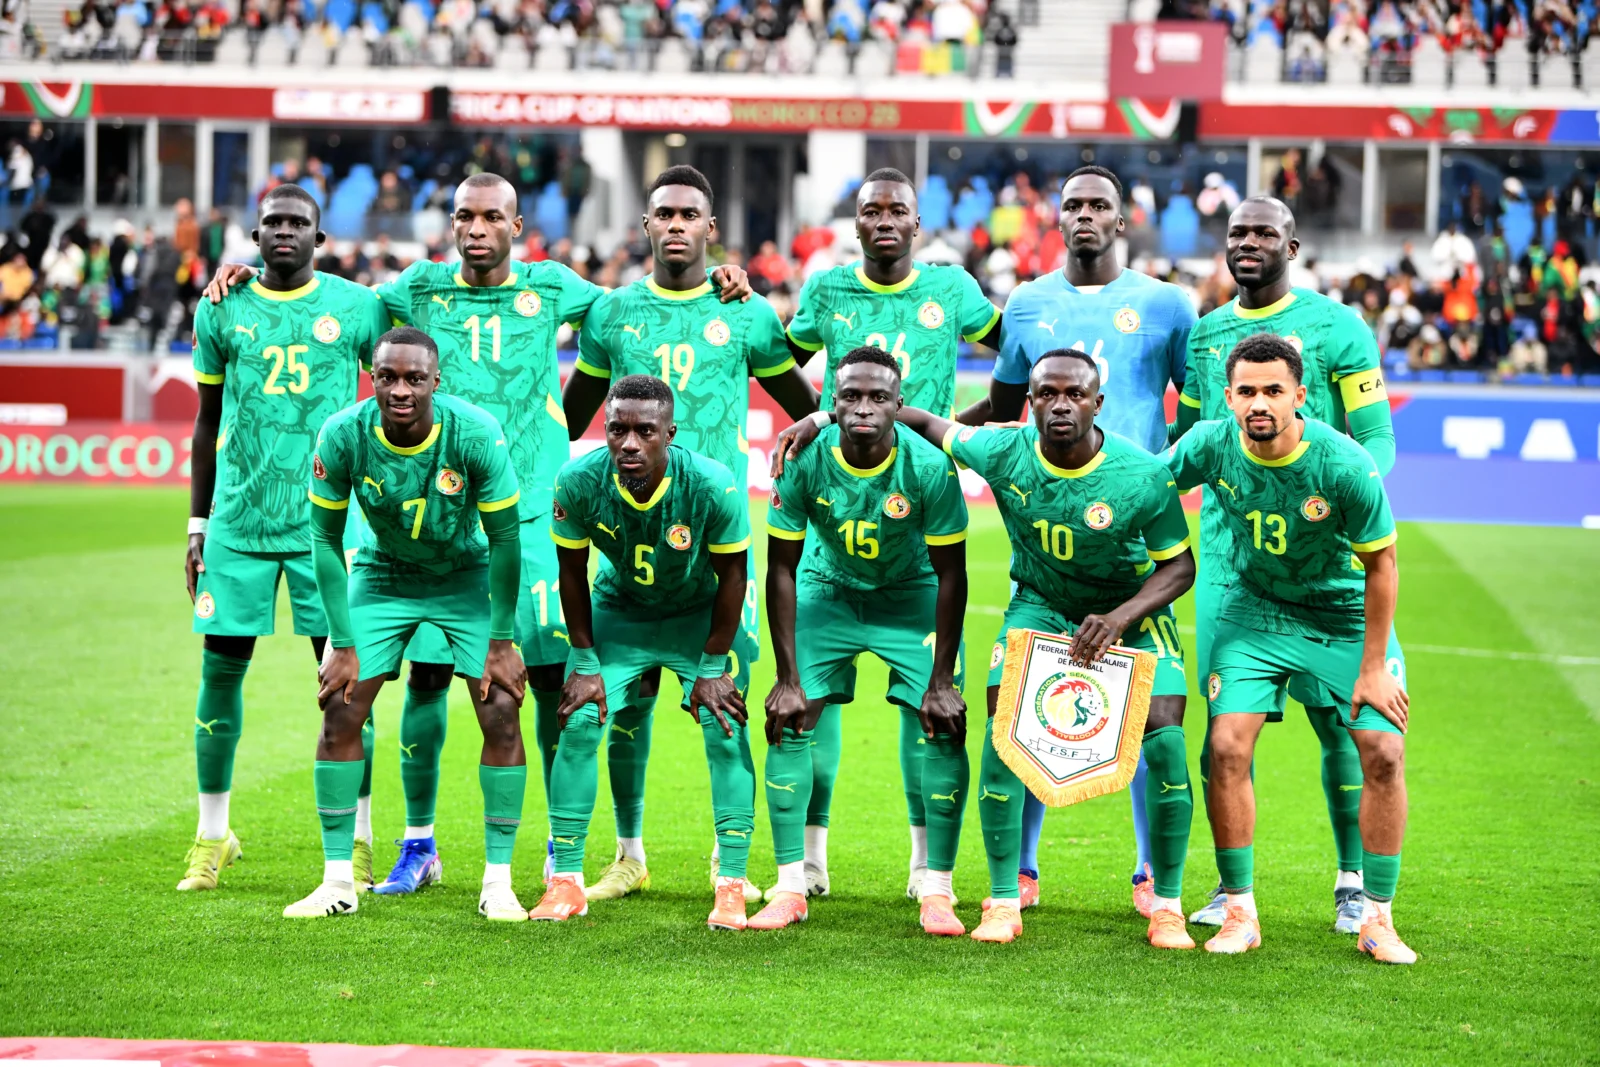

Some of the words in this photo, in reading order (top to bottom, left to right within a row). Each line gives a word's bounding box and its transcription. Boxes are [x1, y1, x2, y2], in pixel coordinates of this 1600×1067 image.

[463, 315, 501, 362] 11
[263, 345, 310, 394] 25
[653, 343, 695, 391] 19
[1071, 339, 1109, 386] 6
[402, 497, 426, 540] 7
[837, 520, 879, 559] 15
[1032, 519, 1074, 561] 10
[1245, 510, 1287, 555] 13
[634, 544, 655, 586] 5
[1140, 615, 1182, 659] 10
[1057, 657, 1067, 665] DE
[1050, 746, 1079, 758] F.S.F
